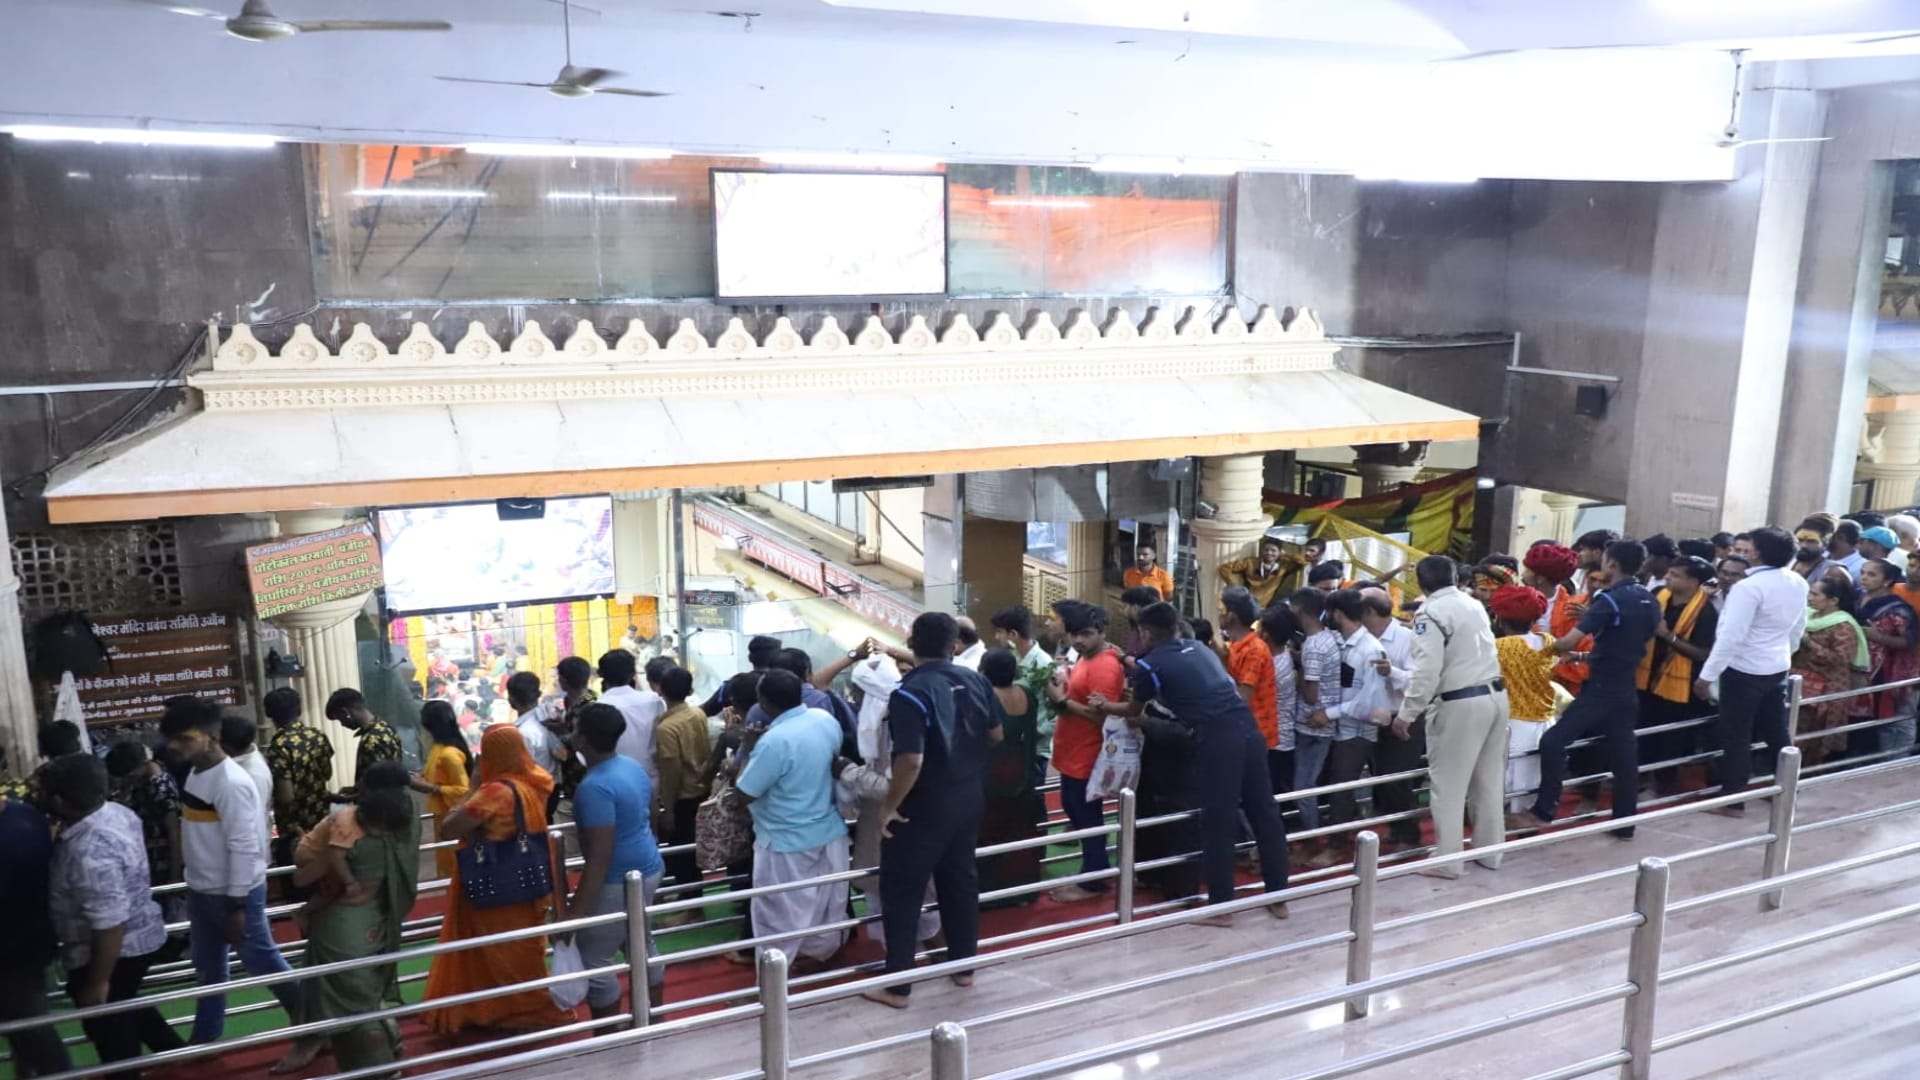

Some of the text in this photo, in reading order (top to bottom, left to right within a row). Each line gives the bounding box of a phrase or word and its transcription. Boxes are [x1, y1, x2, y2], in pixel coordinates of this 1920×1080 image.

[120, 618, 145, 634] मंदिर
[146, 617, 167, 632] प्रबंध
[169, 614, 199, 630] समिति
